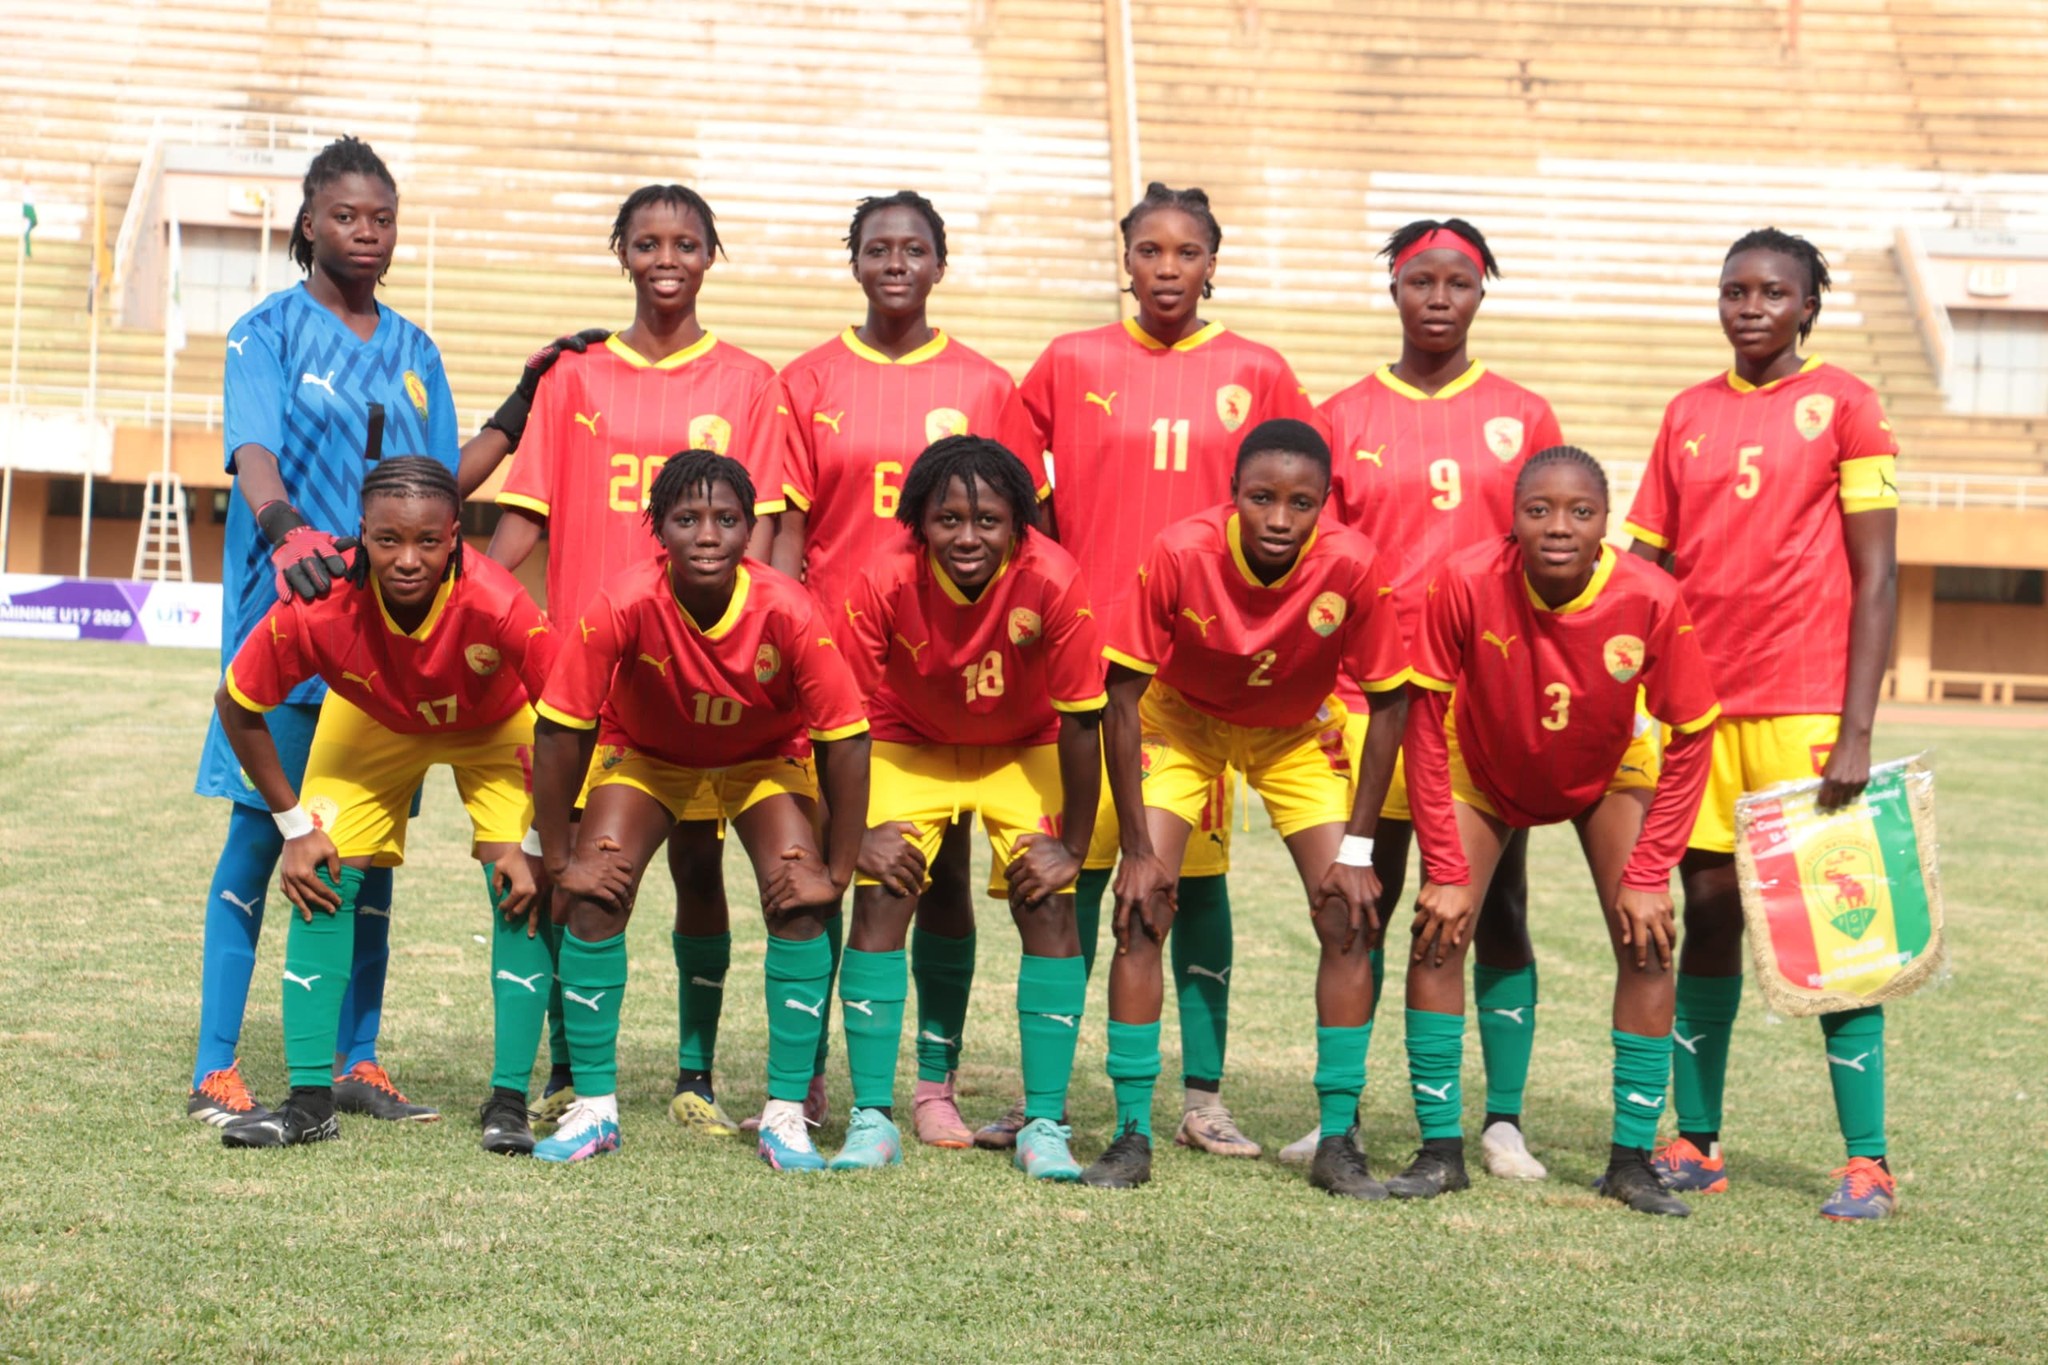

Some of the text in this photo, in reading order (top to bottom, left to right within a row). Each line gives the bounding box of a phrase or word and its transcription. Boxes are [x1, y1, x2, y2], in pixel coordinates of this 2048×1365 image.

[1151, 418, 1190, 472] 11
[873, 461, 903, 518] 6
[1429, 459, 1462, 511] 9
[1735, 446, 1764, 500] 5
[59, 606, 91, 626] U17
[92, 608, 133, 628] 2026
[156, 607, 201, 625] U17
[961, 651, 1005, 704] 18
[1247, 650, 1277, 687] 2
[416, 694, 458, 727] 17
[692, 692, 743, 727] 10
[1541, 682, 1571, 731] 3
[1319, 729, 1351, 770] 2
